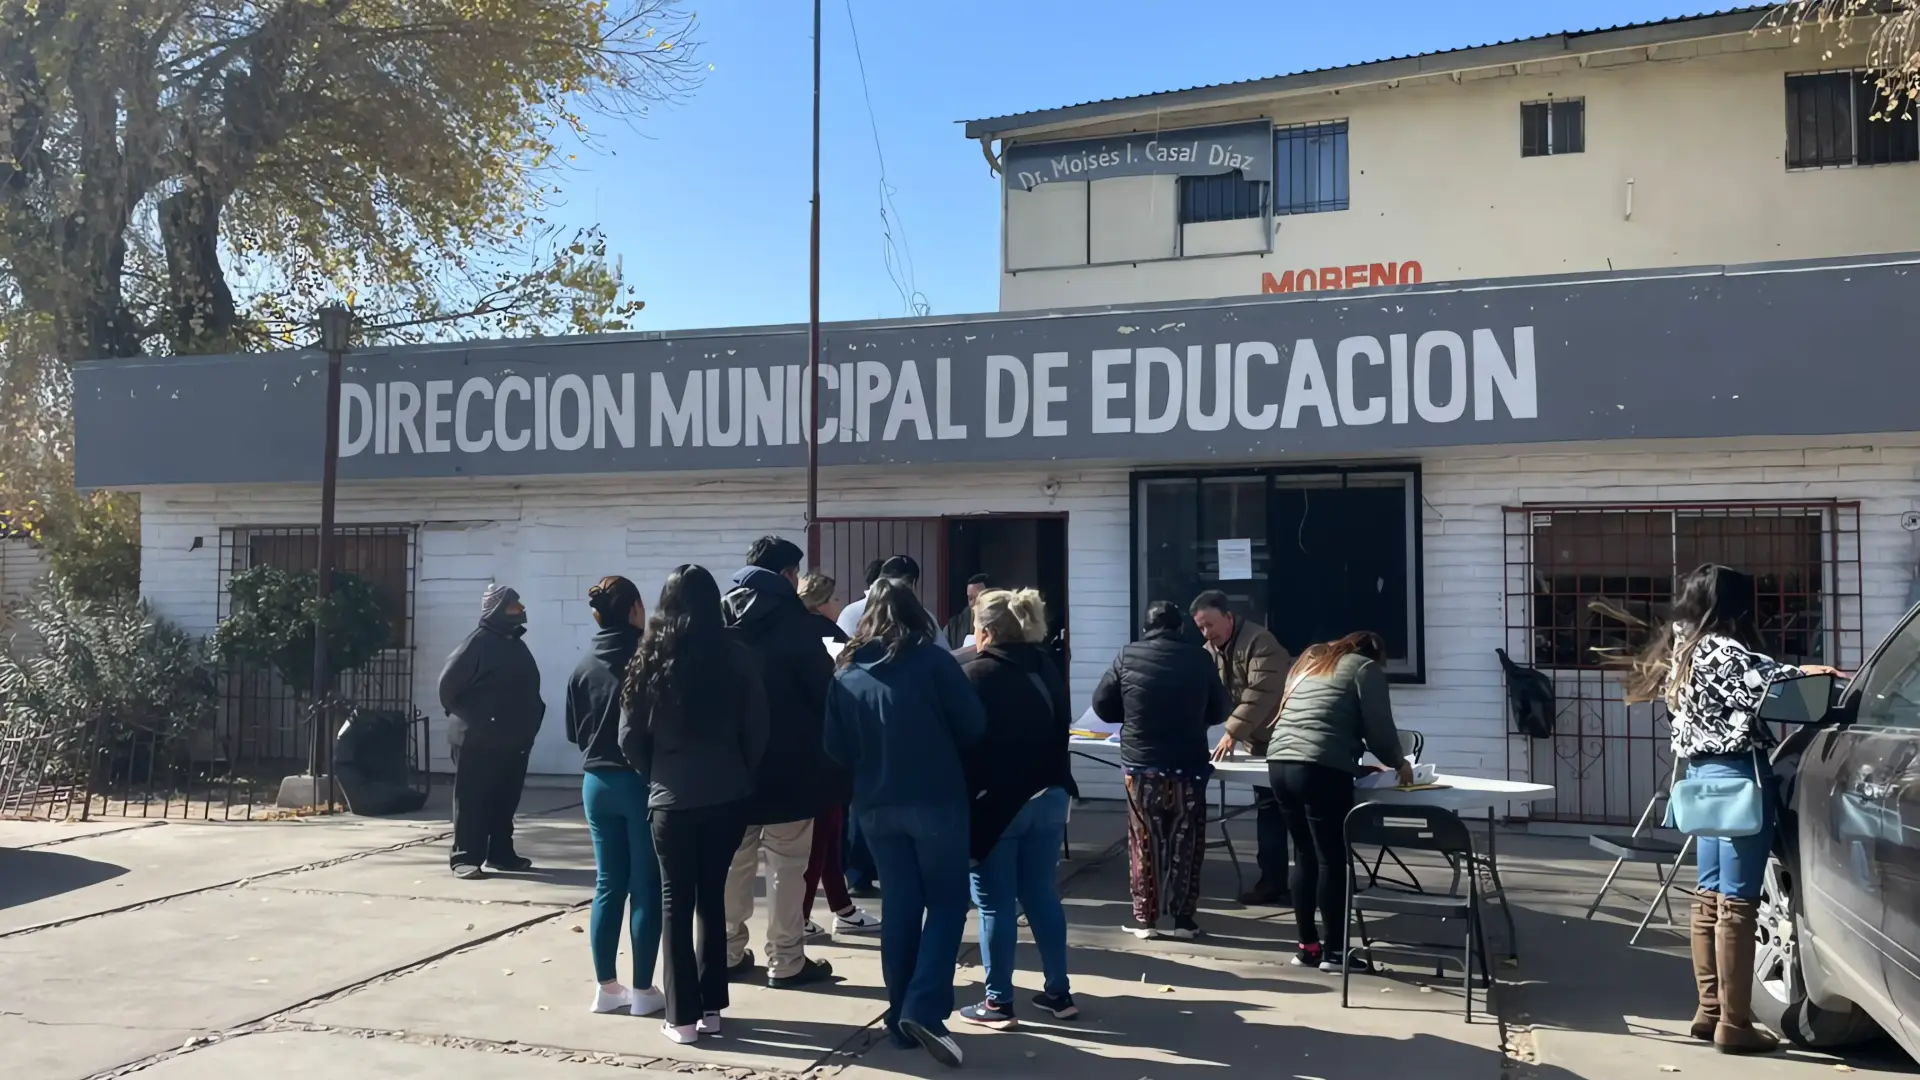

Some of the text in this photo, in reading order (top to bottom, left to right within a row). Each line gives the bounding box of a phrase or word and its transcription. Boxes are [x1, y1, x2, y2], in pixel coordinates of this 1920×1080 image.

[1018, 140, 1254, 190] Dr. Moisés I. Casal Díaz
[1262, 260, 1422, 294] MORENO
[338, 326, 1538, 458] DIRECCION MUNICIPAL DE EDUCACION
